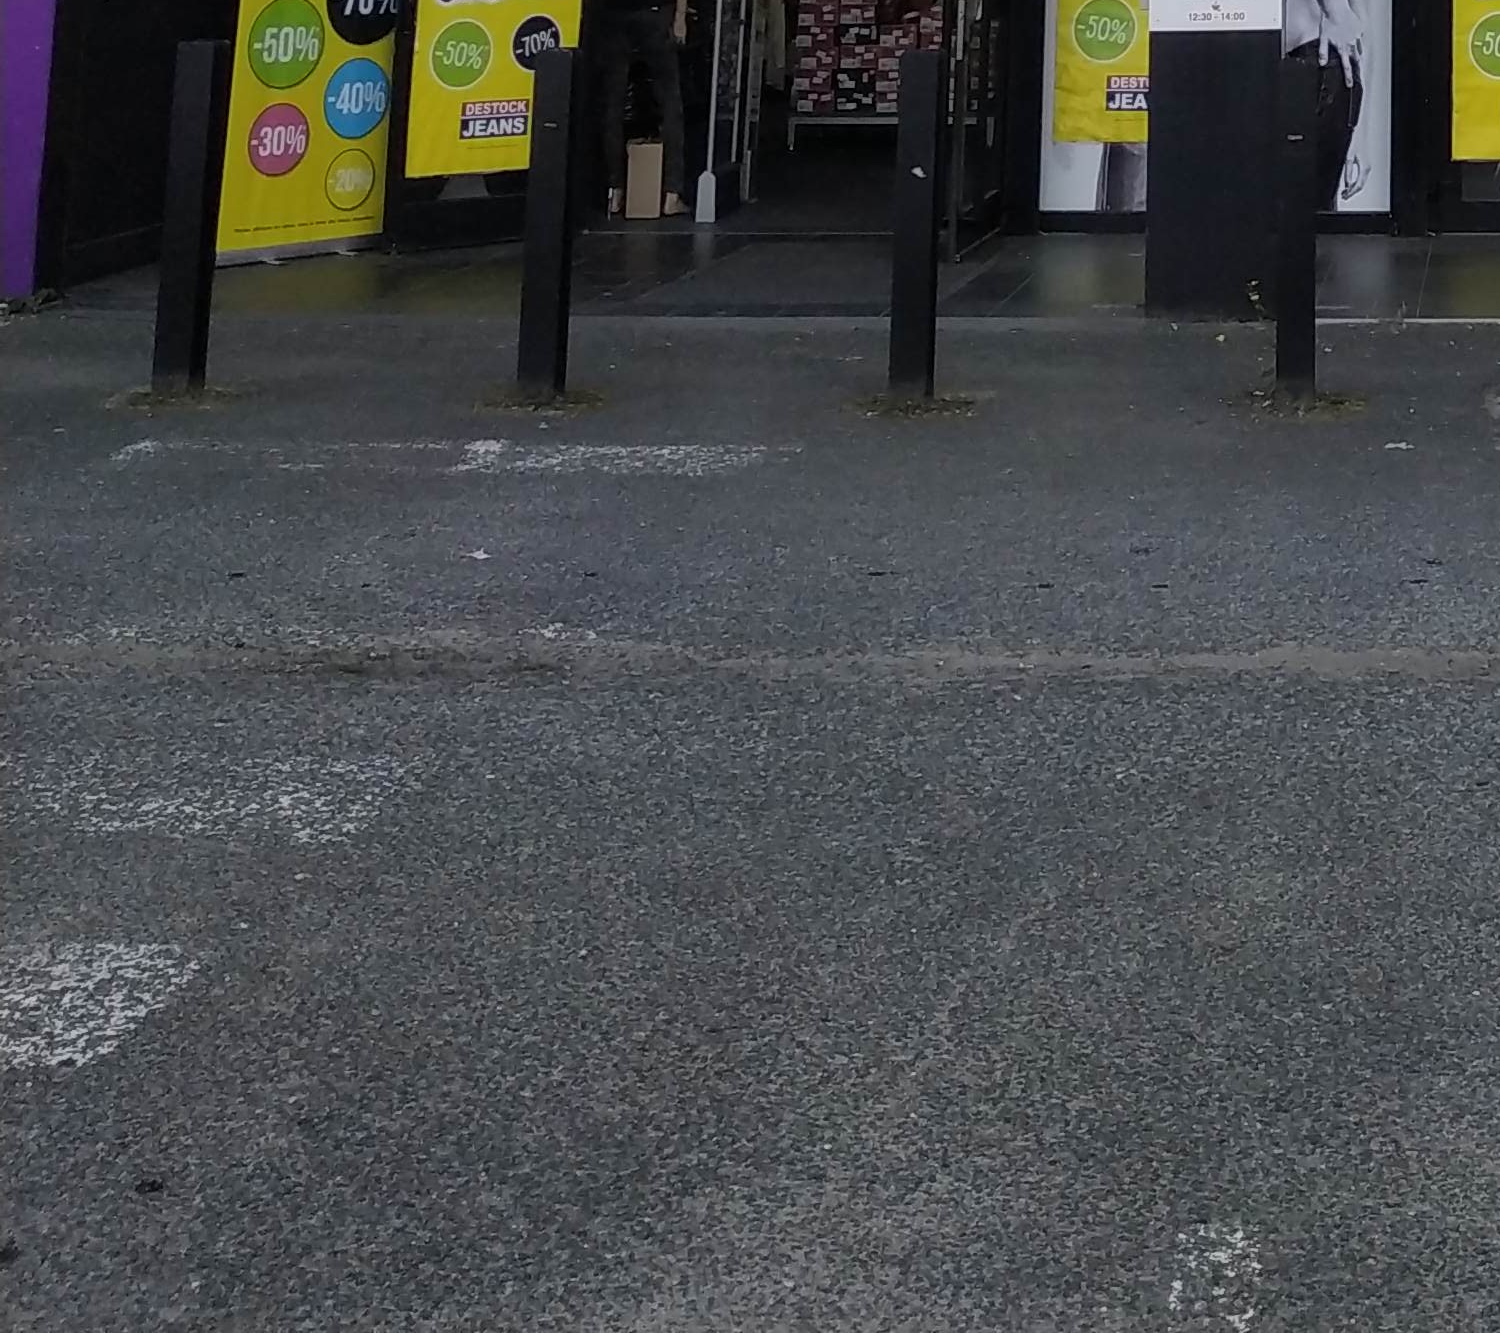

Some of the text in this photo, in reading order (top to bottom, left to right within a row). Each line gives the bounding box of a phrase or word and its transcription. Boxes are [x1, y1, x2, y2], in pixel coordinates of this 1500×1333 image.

[465, 100, 527, 116] DESTOCK
[1108, 93, 1148, 109] JEA
[462, 117, 526, 137] JEANS
